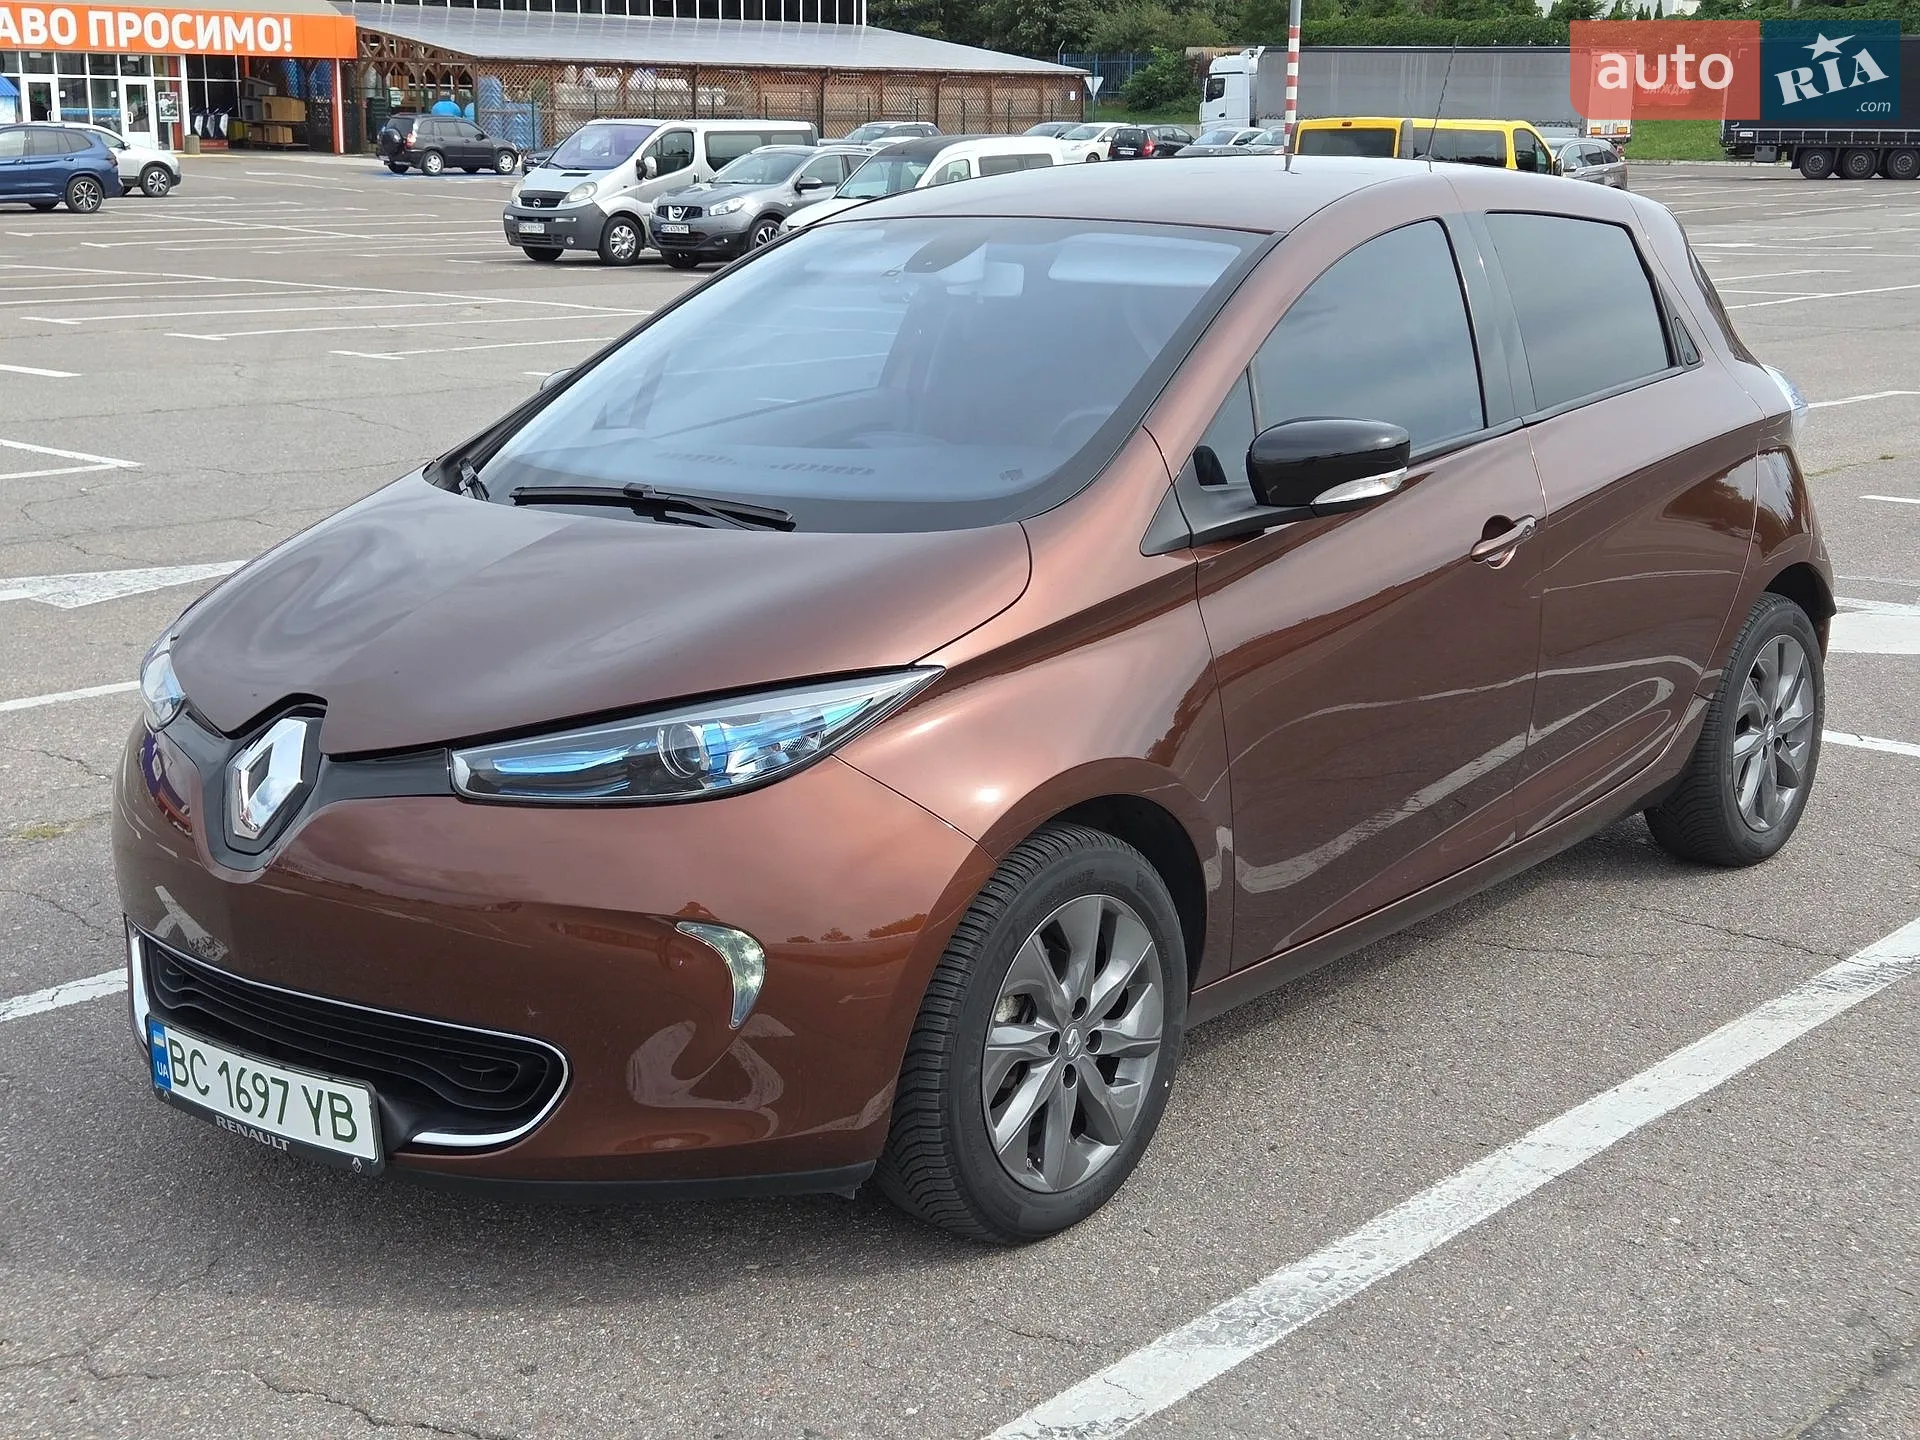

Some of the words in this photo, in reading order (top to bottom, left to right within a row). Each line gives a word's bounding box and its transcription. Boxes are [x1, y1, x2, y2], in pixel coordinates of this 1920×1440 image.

[88, 10, 293, 53] ПРОСИМО!
[157, 1061, 169, 1079] UA
[167, 1037, 210, 1096] BC
[217, 1061, 289, 1125] 1697
[301, 1085, 358, 1143] YB
[215, 1115, 290, 1151] RENAULT
